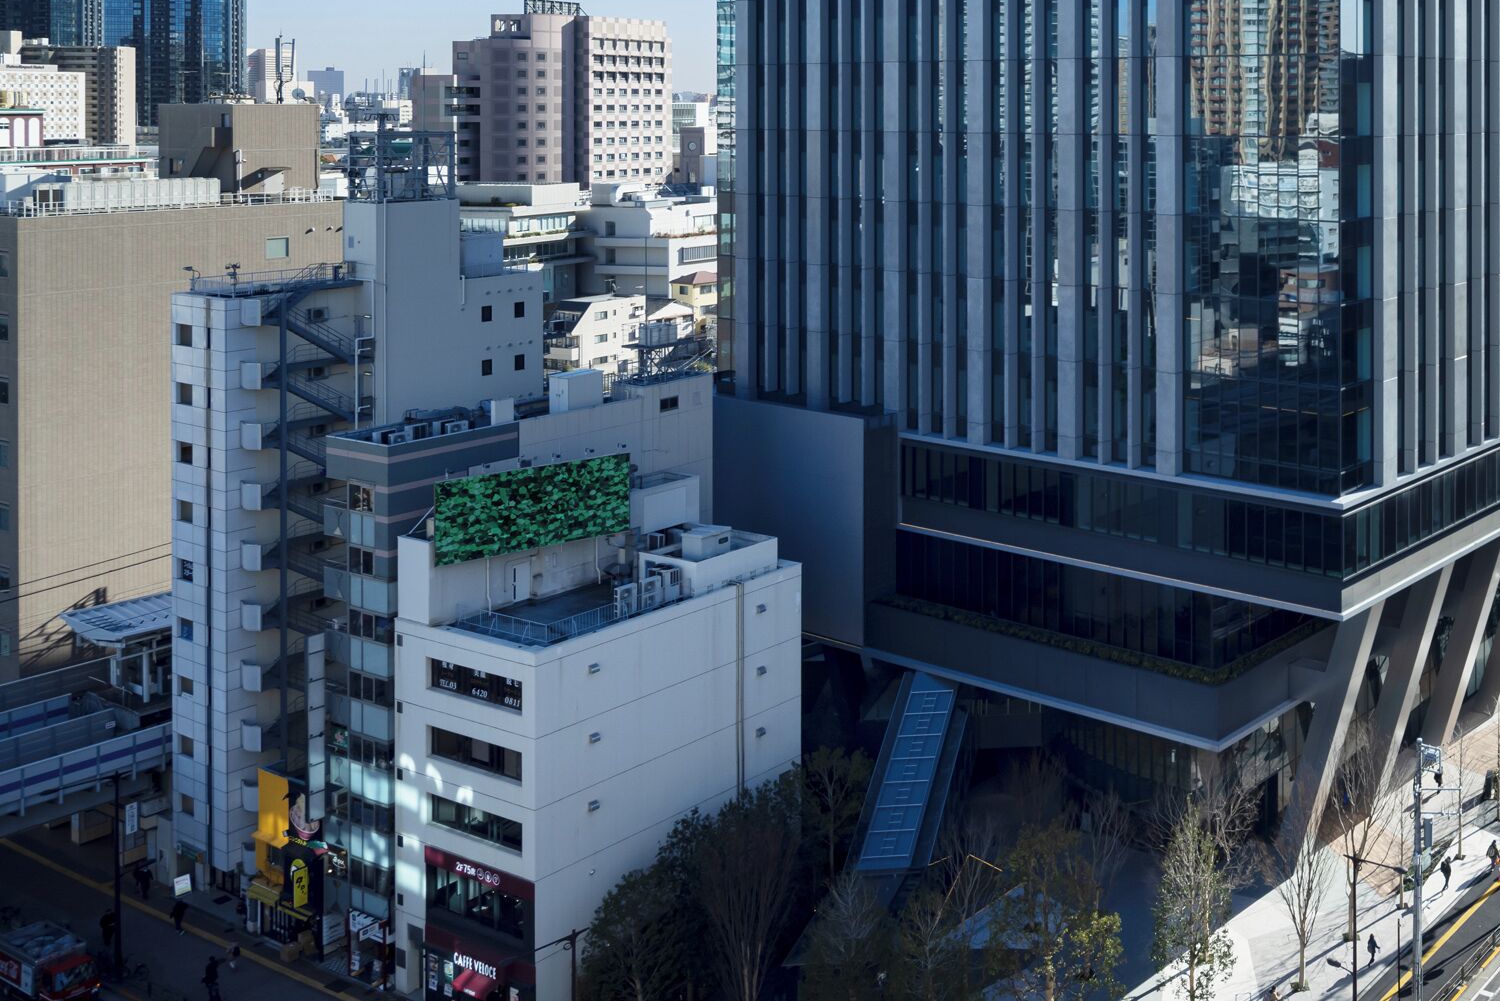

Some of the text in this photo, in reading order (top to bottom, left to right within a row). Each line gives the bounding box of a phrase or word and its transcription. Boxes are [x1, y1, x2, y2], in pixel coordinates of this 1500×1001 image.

[472, 687, 488, 698] 6420
[504, 696, 520, 707] 0811
[453, 952, 497, 980] CAFFE VELOCE
